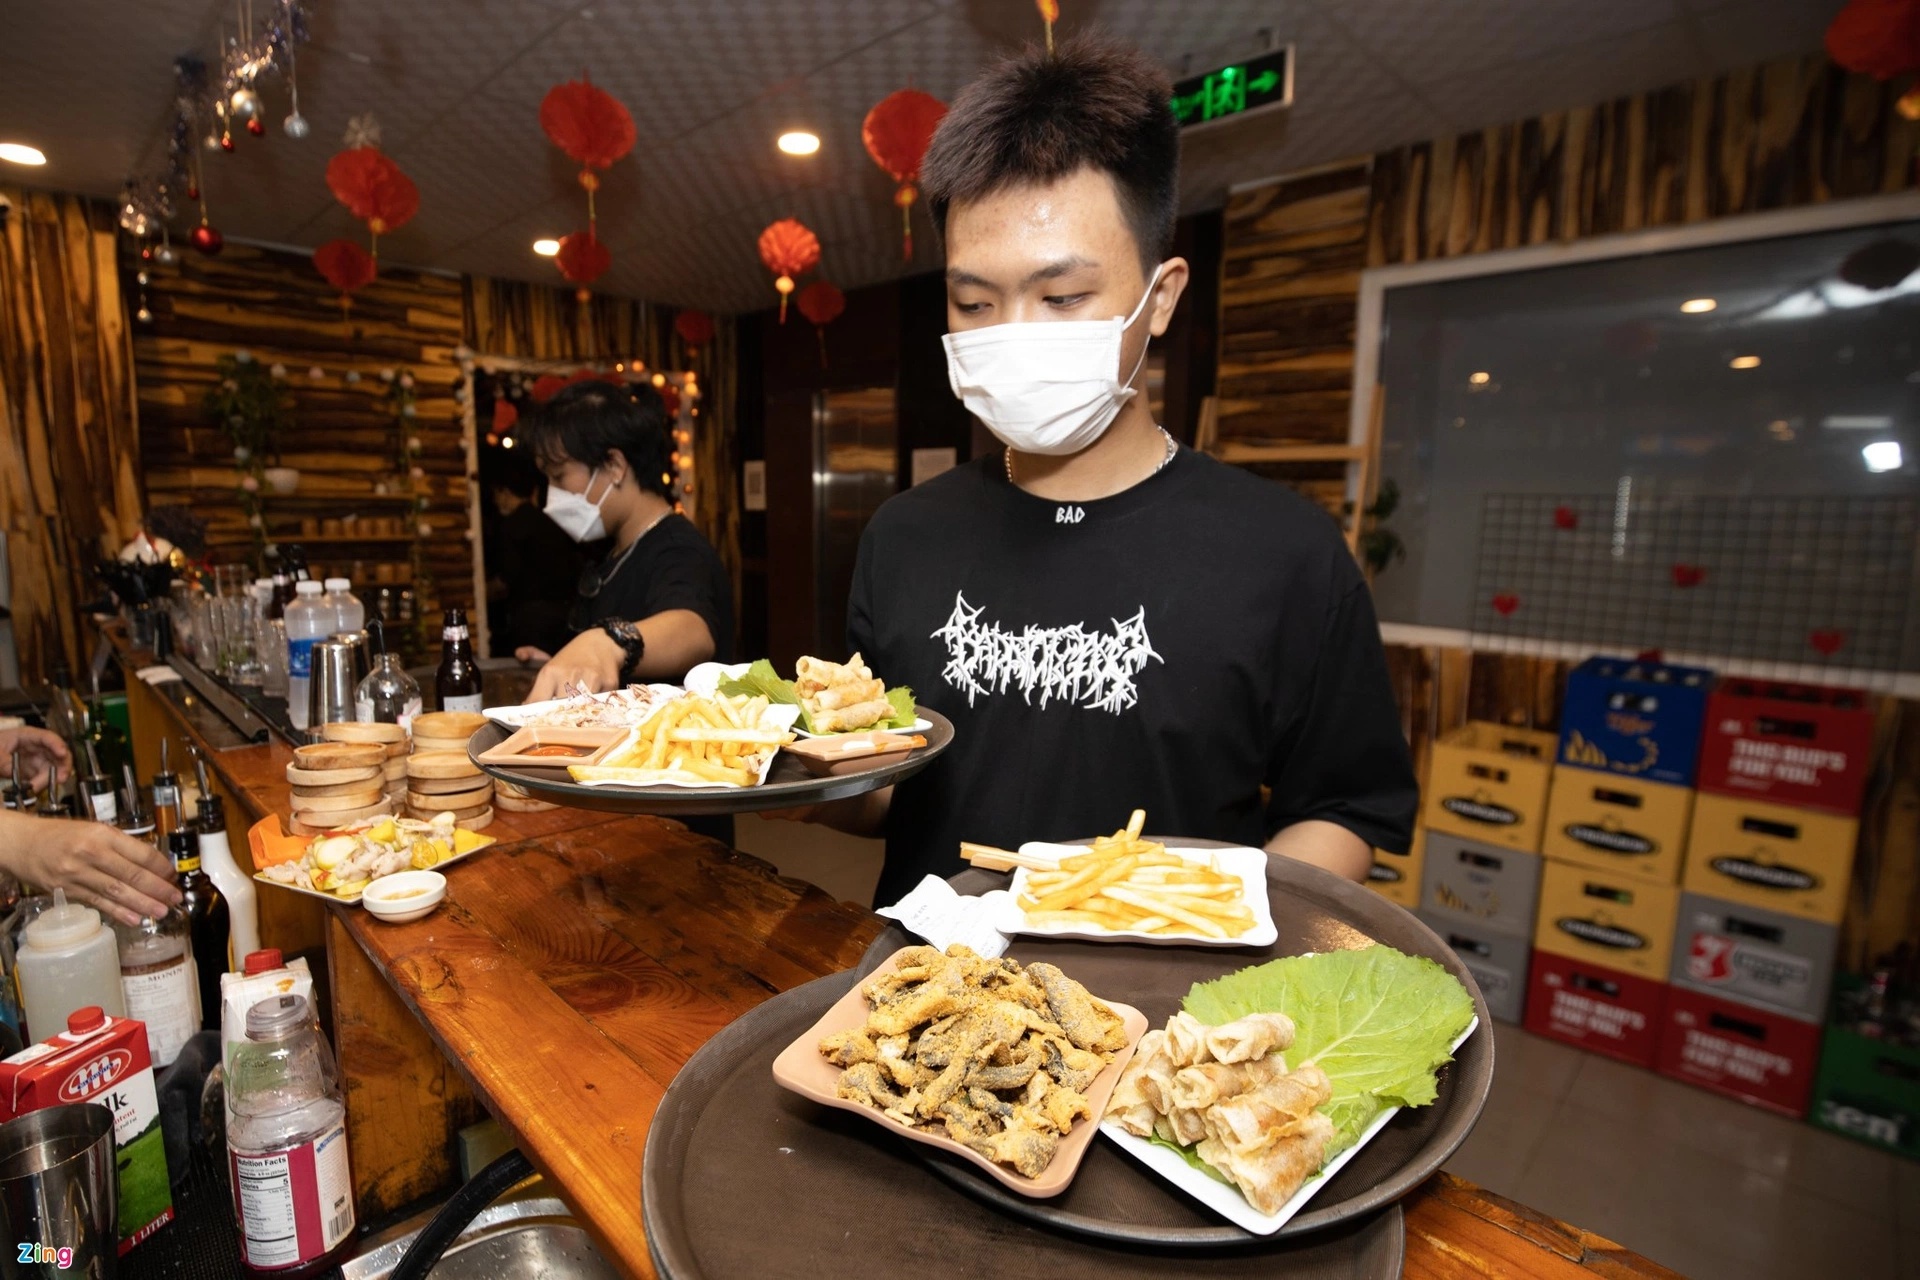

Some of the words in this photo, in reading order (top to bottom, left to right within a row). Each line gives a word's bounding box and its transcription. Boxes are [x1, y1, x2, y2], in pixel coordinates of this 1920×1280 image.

[1055, 505, 1085, 524] BAD
[104, 1091, 129, 1112] lk
[114, 1108, 135, 1124] ntent
[238, 1158, 263, 1167] Nutrition
[264, 1157, 287, 1166] Facts
[131, 1235, 137, 1247] 1
[140, 1212, 169, 1240] LITER
